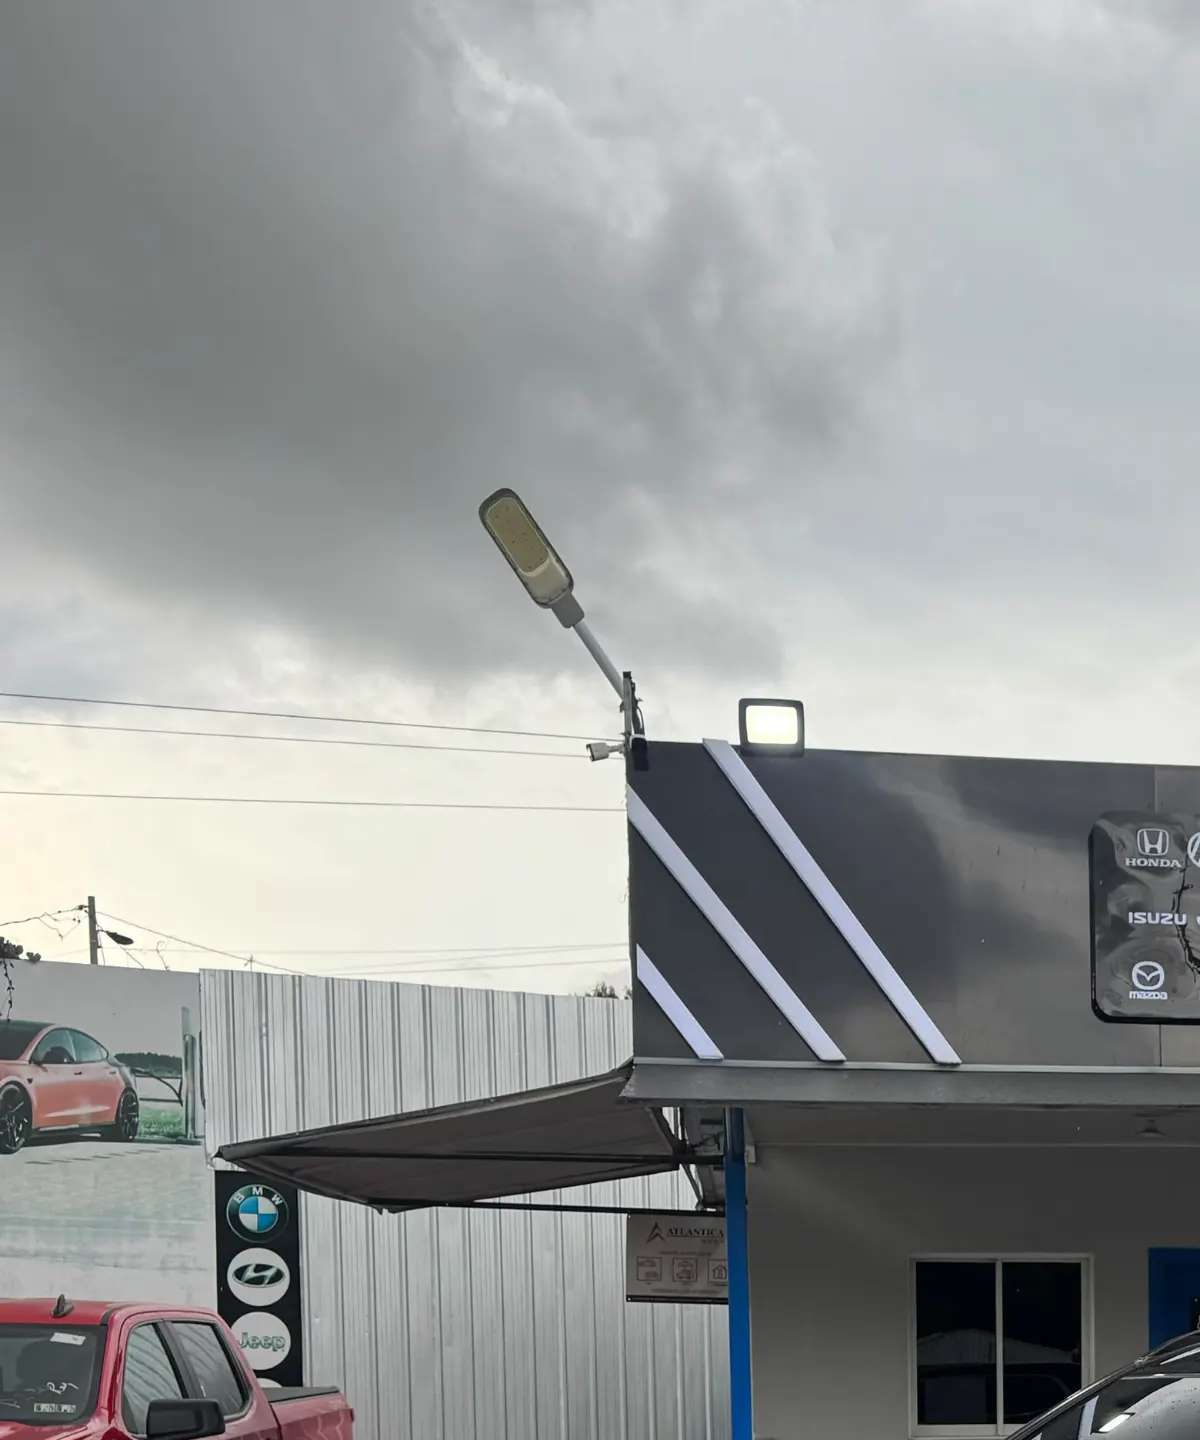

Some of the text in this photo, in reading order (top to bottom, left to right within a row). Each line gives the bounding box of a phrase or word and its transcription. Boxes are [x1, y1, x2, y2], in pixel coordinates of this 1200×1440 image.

[1124, 857, 1182, 868] HONDA
[1128, 911, 1187, 925] ISUZU
[233, 1186, 284, 1206] BMW
[240, 1332, 286, 1352] Jeep
